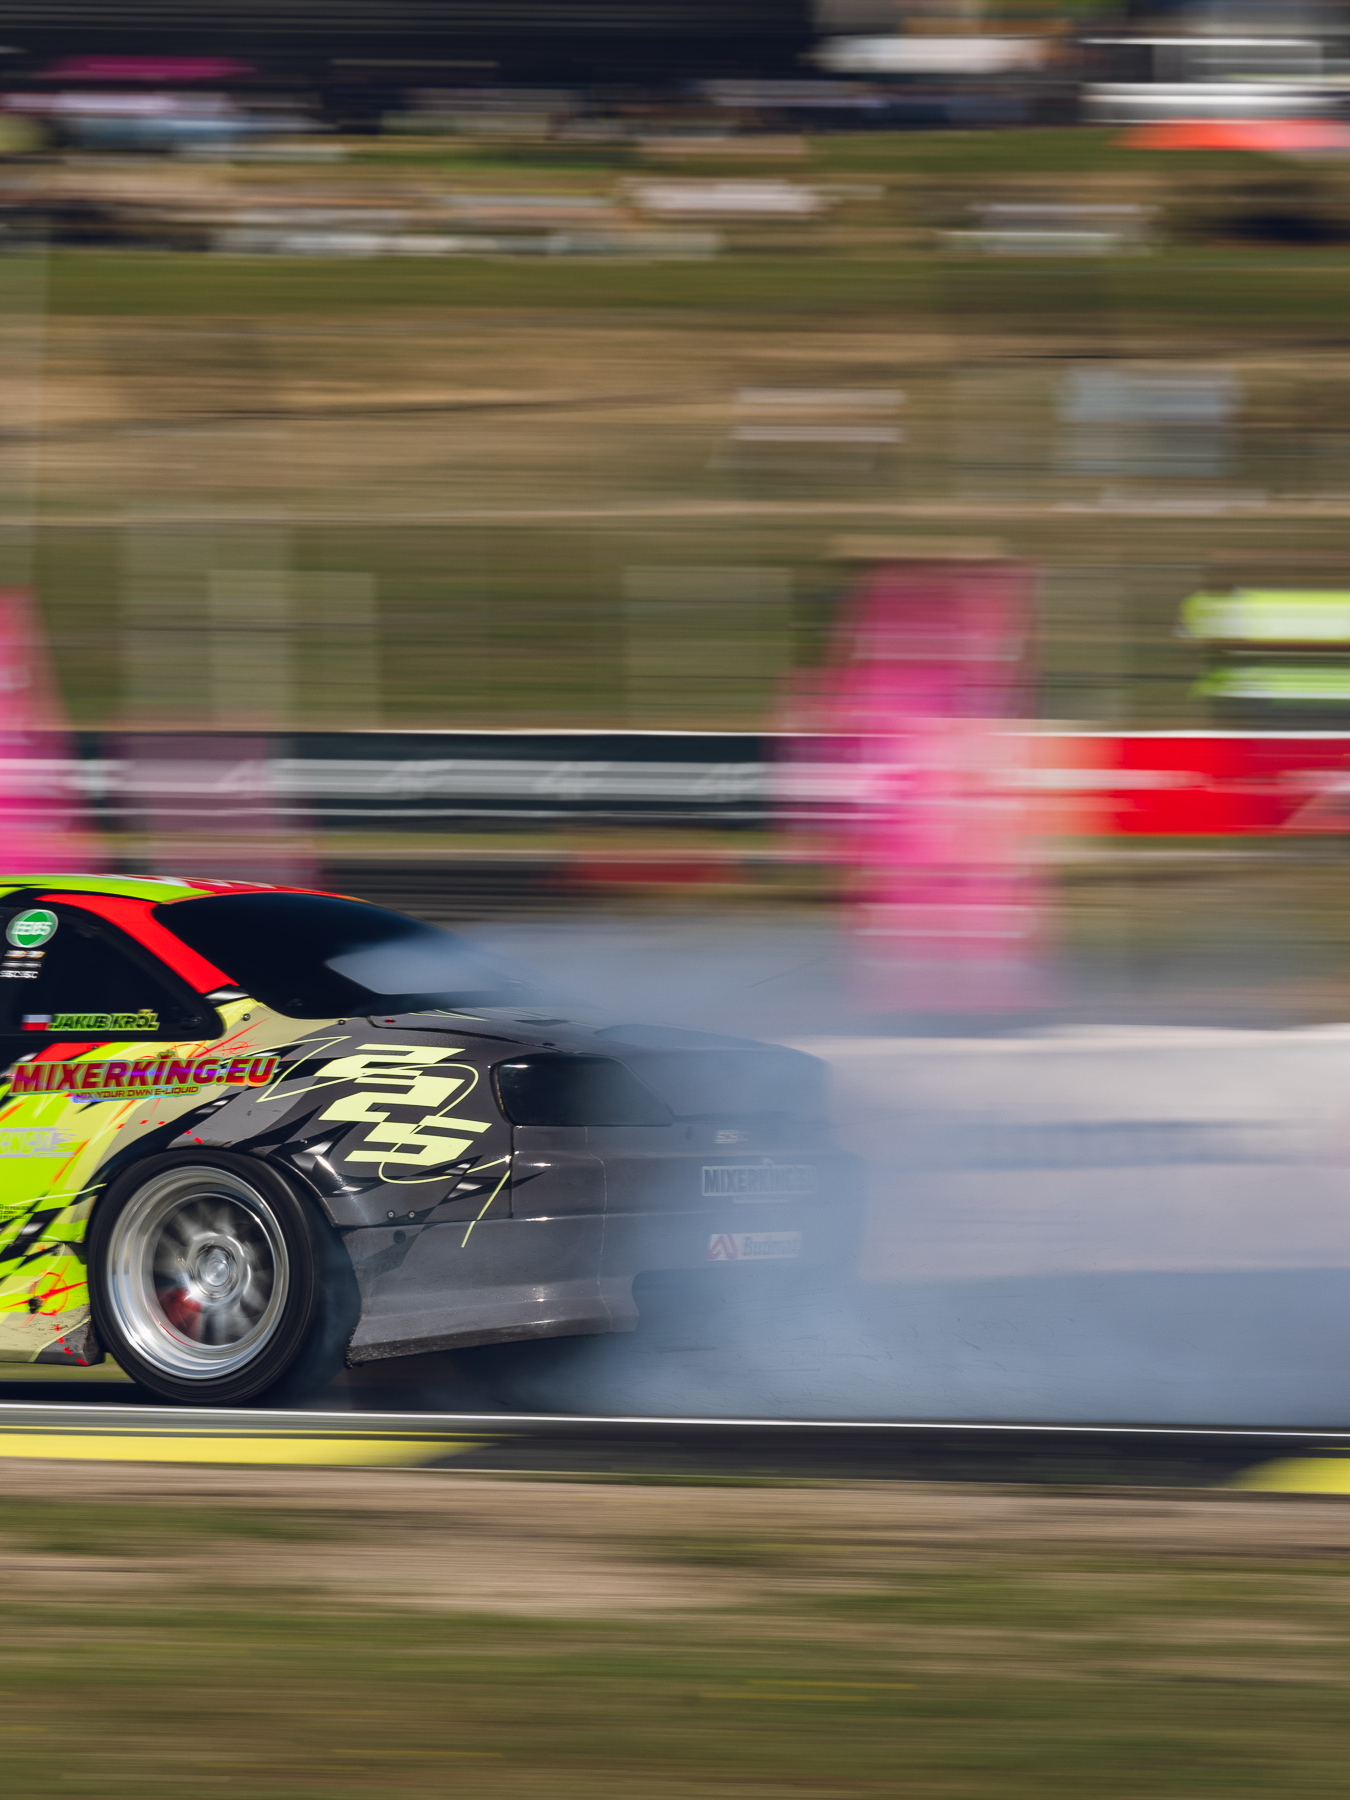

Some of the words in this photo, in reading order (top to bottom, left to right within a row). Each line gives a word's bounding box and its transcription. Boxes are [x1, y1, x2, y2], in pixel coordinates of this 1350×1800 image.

[52, 1013, 111, 1031] JAKUB
[11, 1057, 279, 1093] MIXERKING.EU
[96, 1090, 125, 1099] YOUR
[127, 1088, 153, 1097] OWN
[155, 1086, 199, 1096] E-LIQUID
